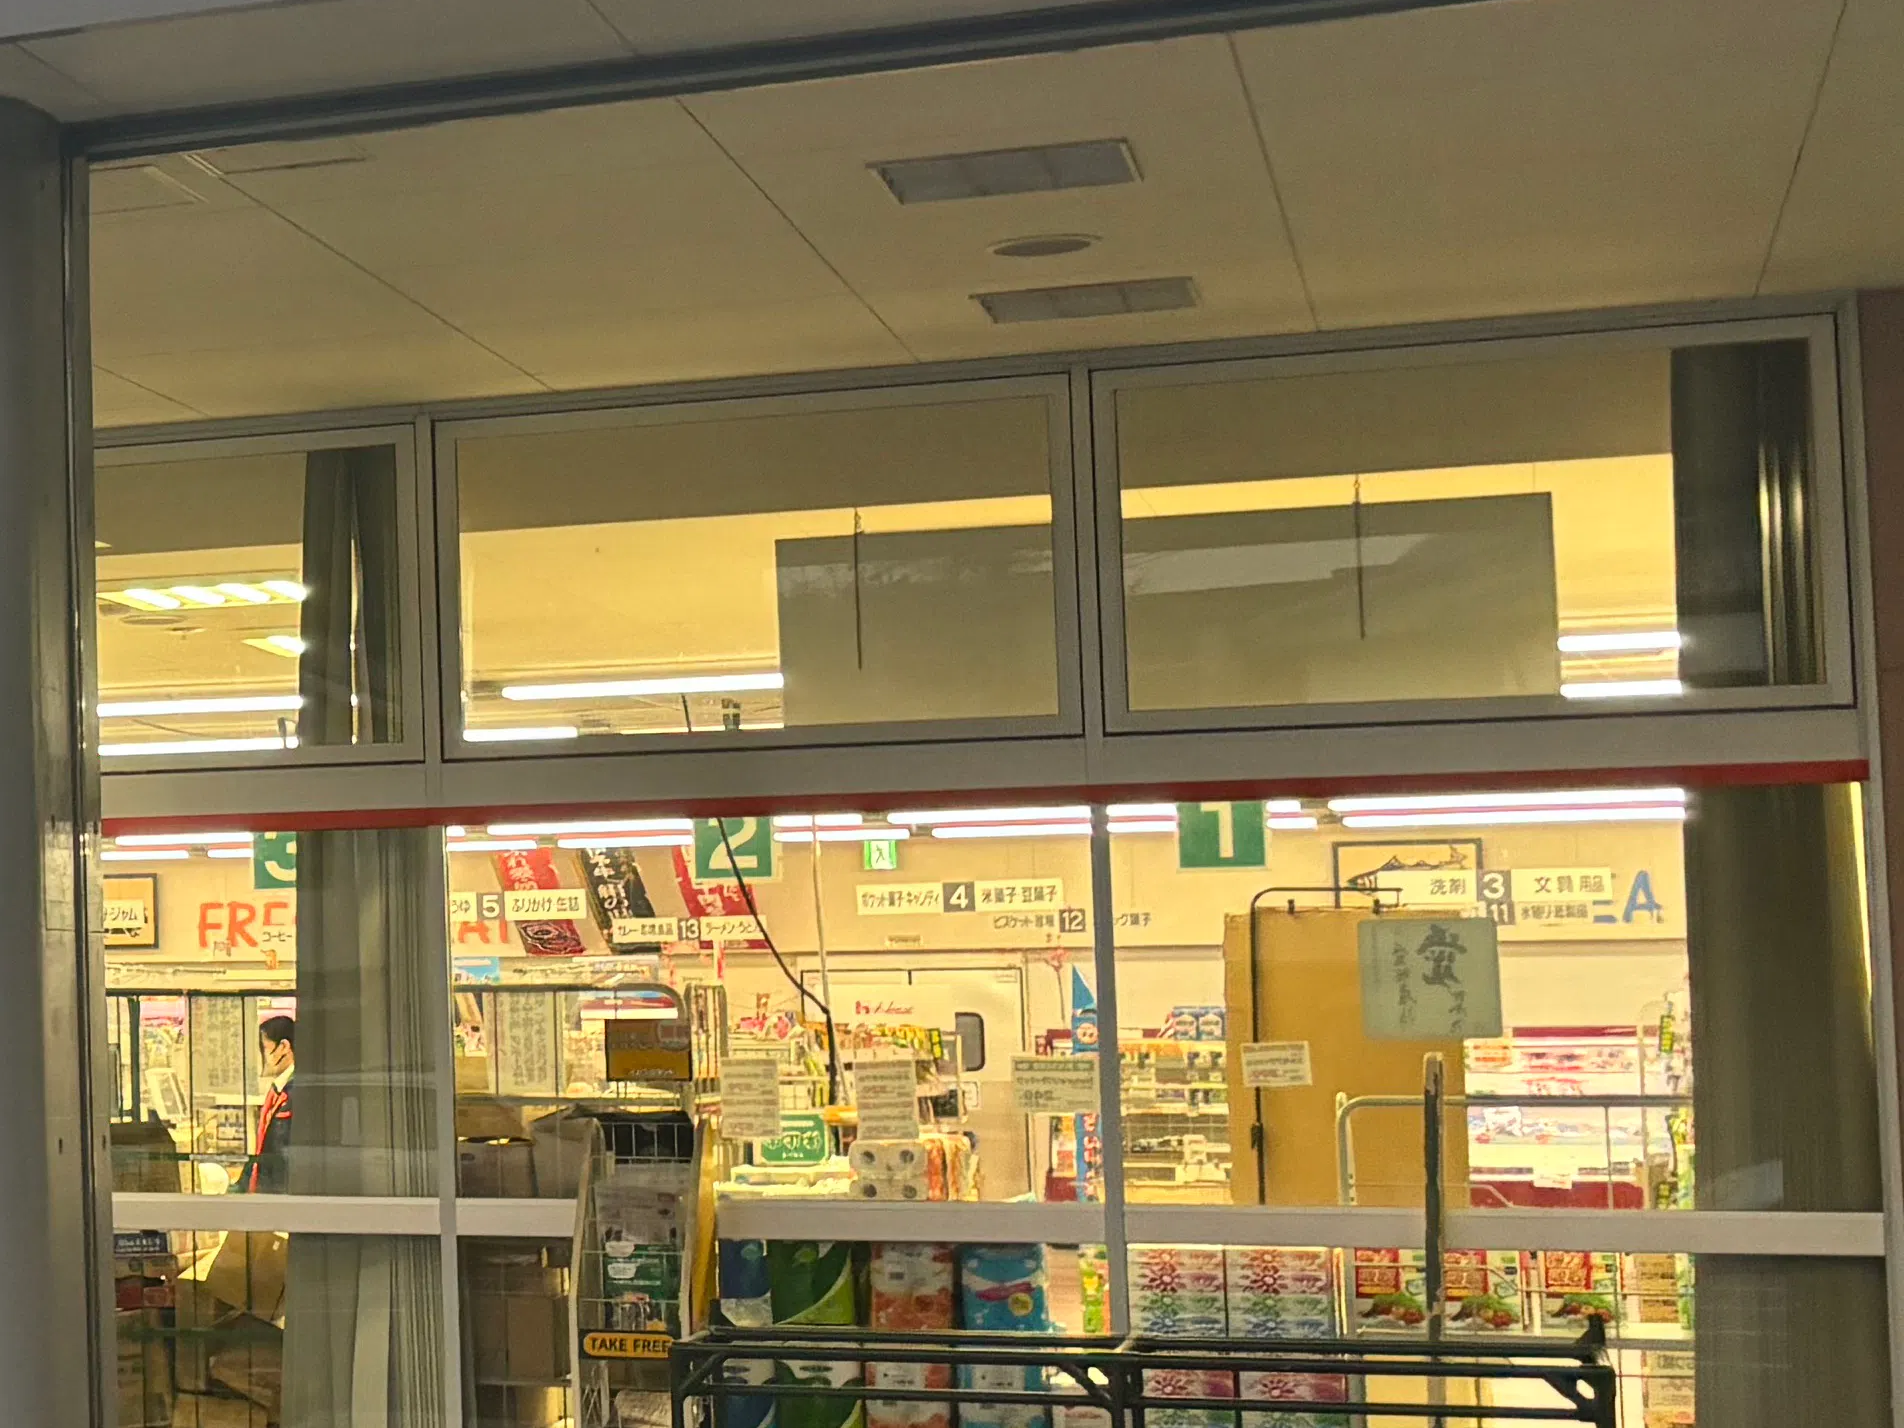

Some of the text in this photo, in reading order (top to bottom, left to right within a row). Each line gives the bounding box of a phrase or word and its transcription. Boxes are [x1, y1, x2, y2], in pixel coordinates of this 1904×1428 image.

[1200, 801, 1234, 858] 1
[708, 817, 758, 870] 2
[948, 884, 969, 909] 4
[1429, 877, 1467, 896] 洗剤
[1482, 872, 1505, 900] 3
[482, 894, 500, 918] 5
[1491, 905, 1509, 922] 11
[679, 920, 699, 940] 13
[1060, 909, 1085, 932] 12
[262, 930, 293, 943] コーヒー
[591, 1337, 672, 1353] TAKE FREE
